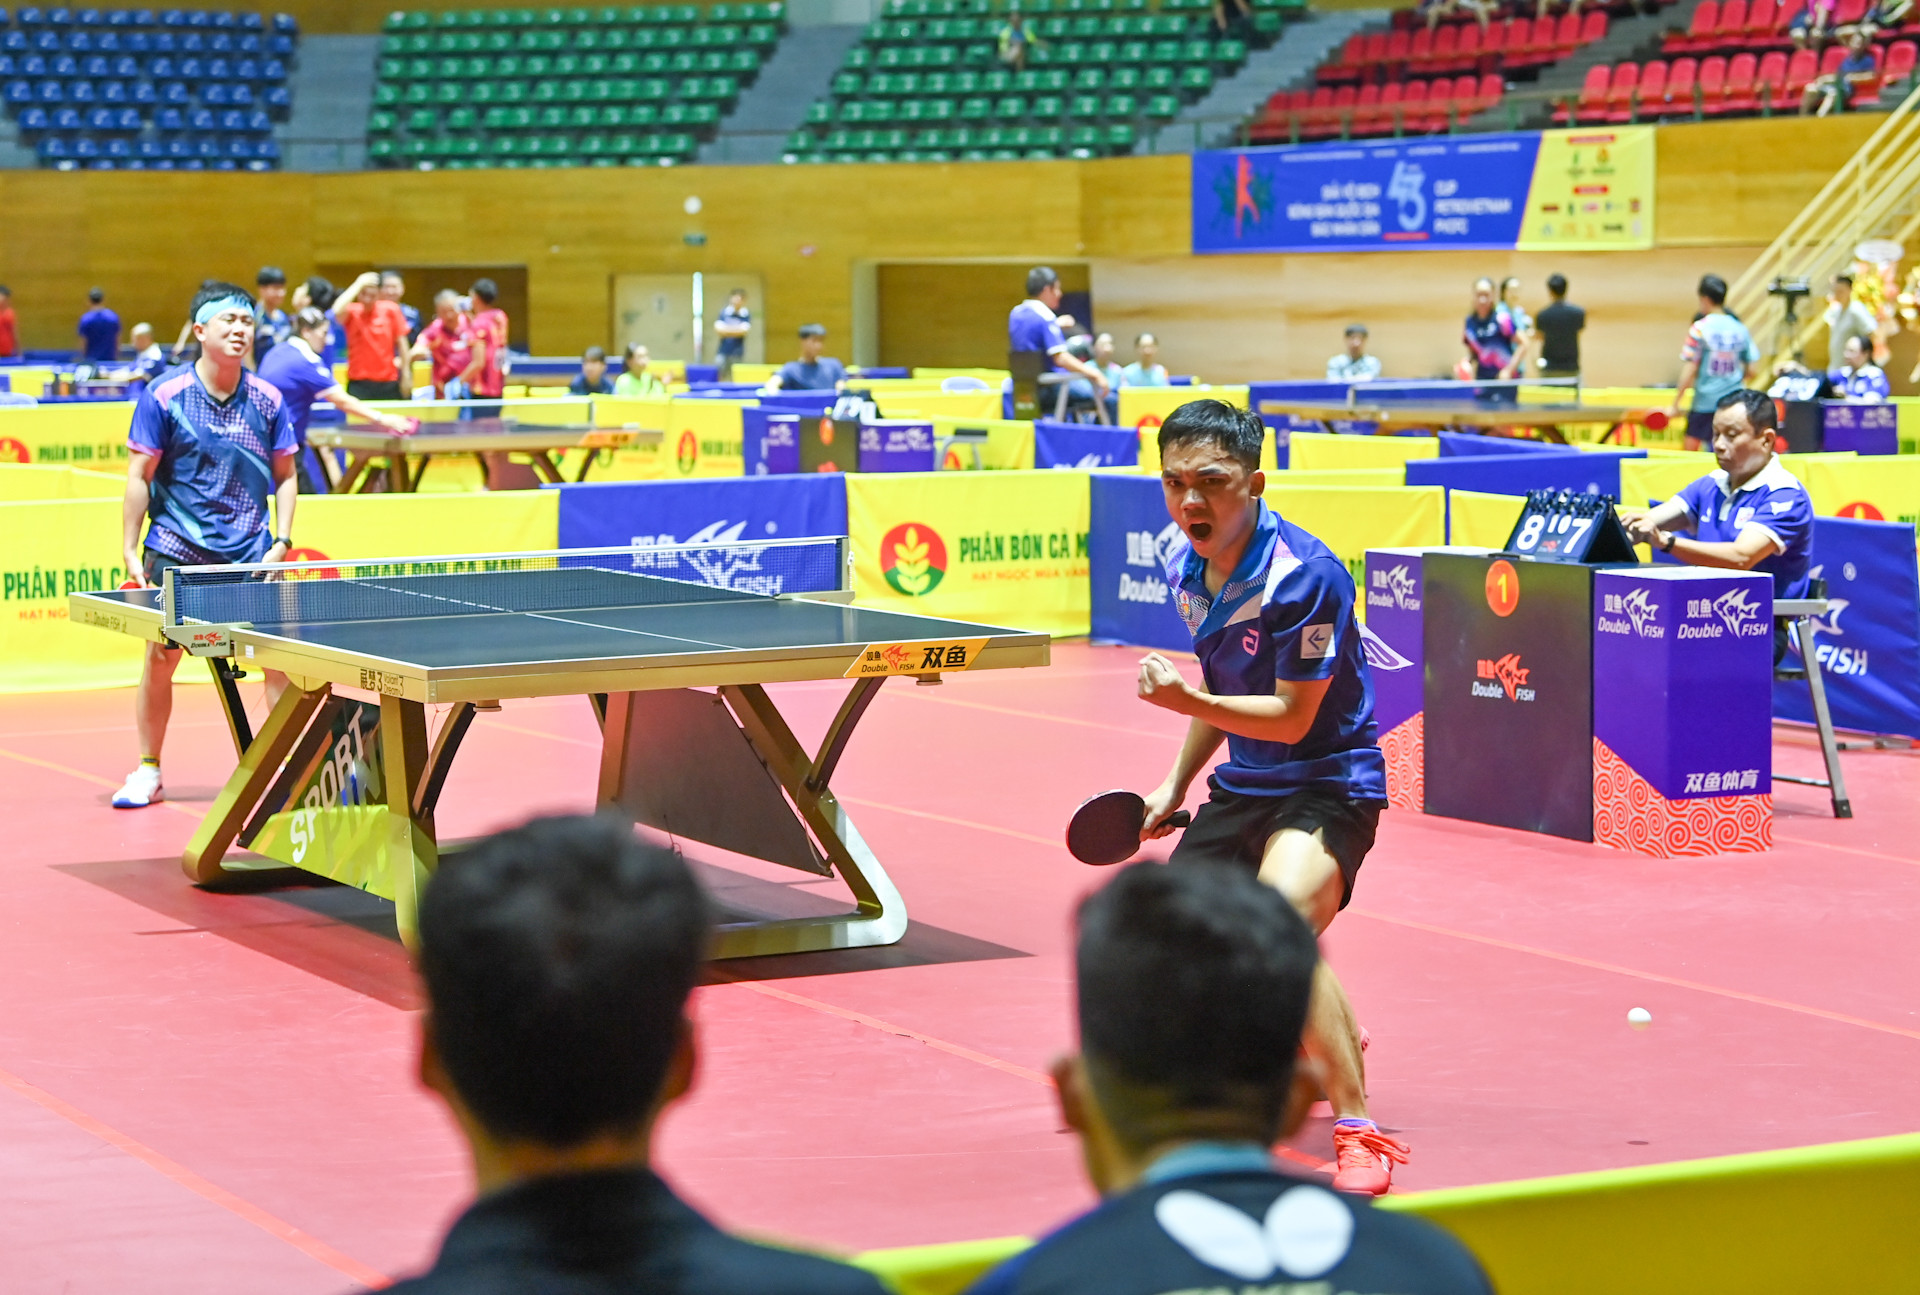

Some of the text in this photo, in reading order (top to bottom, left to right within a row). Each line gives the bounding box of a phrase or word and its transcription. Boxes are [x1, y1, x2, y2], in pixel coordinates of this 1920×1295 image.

[960, 531, 1004, 562] PHÂN
[1516, 514, 1546, 551] 8
[1563, 518, 1593, 554] 7
[4, 565, 57, 600] PHÂN
[1118, 573, 1169, 604] Double
[1497, 573, 1508, 603] 1
[1367, 590, 1394, 608] Double
[1597, 616, 1665, 639] Double FISH
[1677, 622, 1769, 640] Double FISH
[861, 663, 915, 673] Double FISH
[920, 645, 966, 669] 双鱼
[1815, 644, 1868, 676] FISH
[1471, 681, 1536, 702] Double FISH
[290, 704, 365, 864] SPORT
[1683, 768, 1761, 794] 双鱼体育
